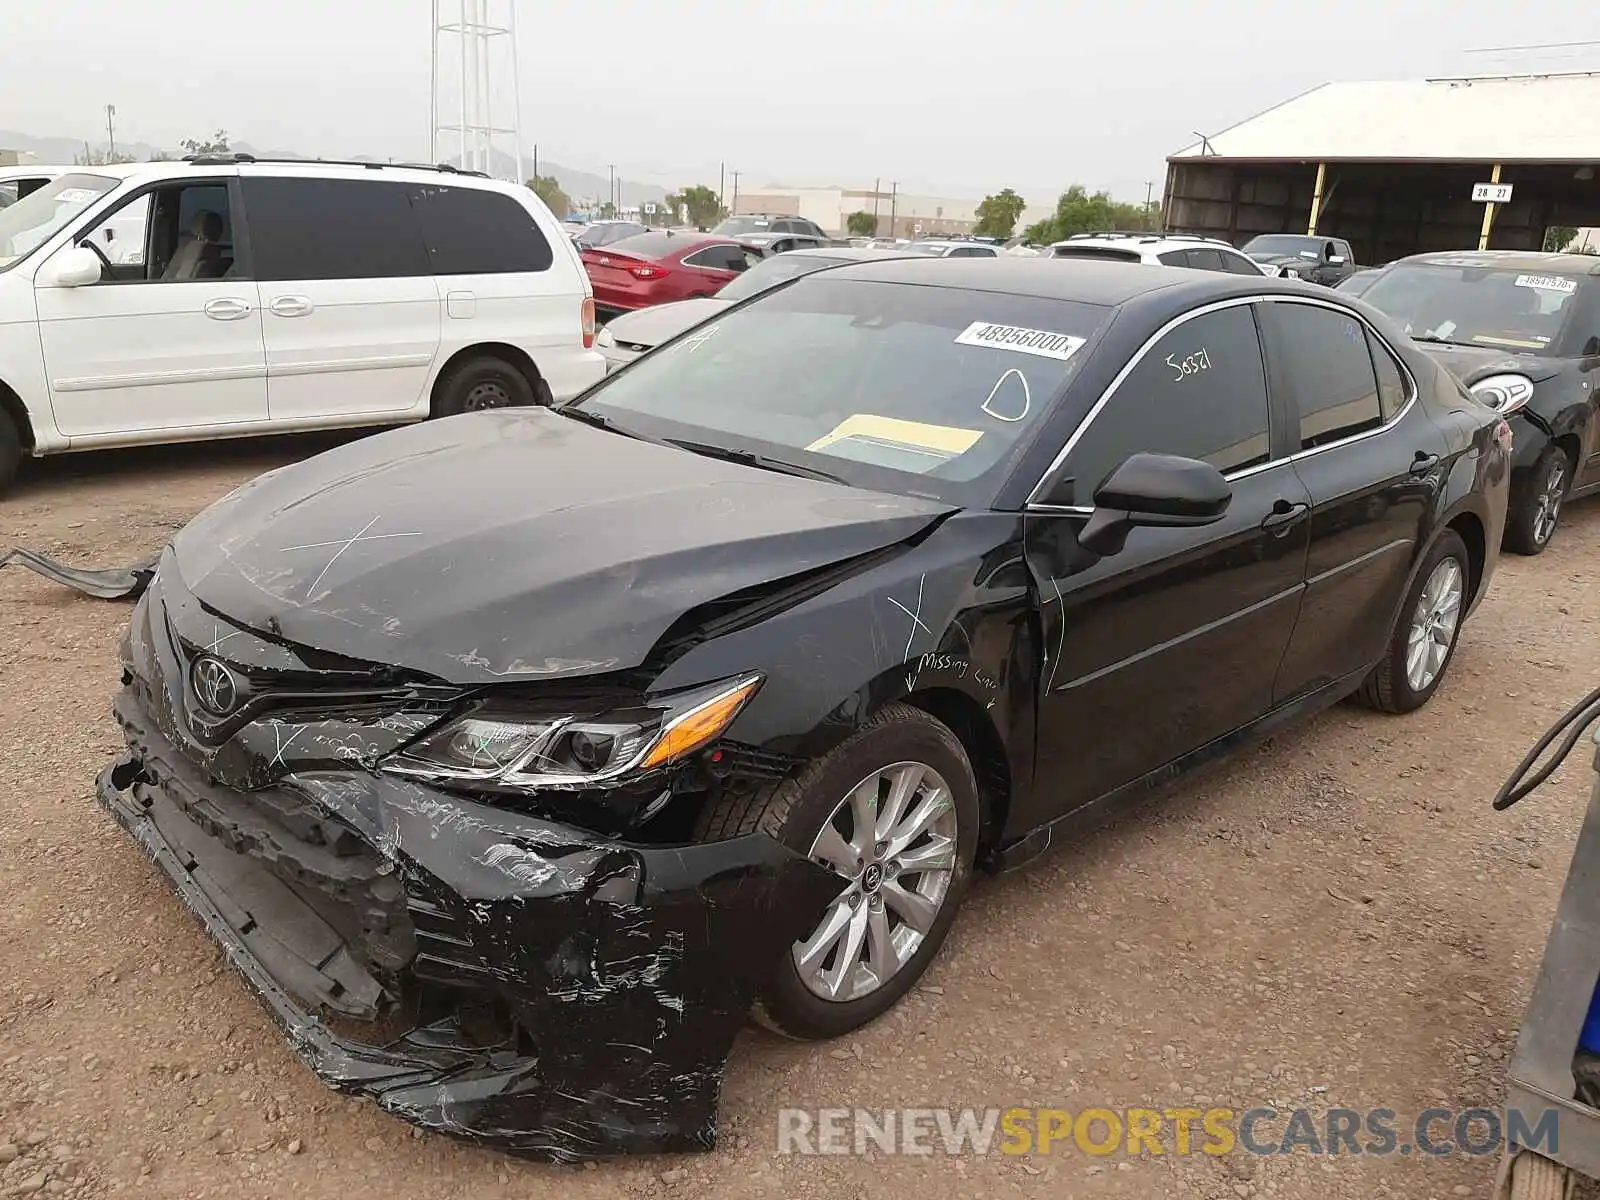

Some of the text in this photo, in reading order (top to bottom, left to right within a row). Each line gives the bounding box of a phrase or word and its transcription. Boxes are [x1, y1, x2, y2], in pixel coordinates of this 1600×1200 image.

[1478, 187, 1507, 198] 28 27
[917, 651, 969, 680] Missing
